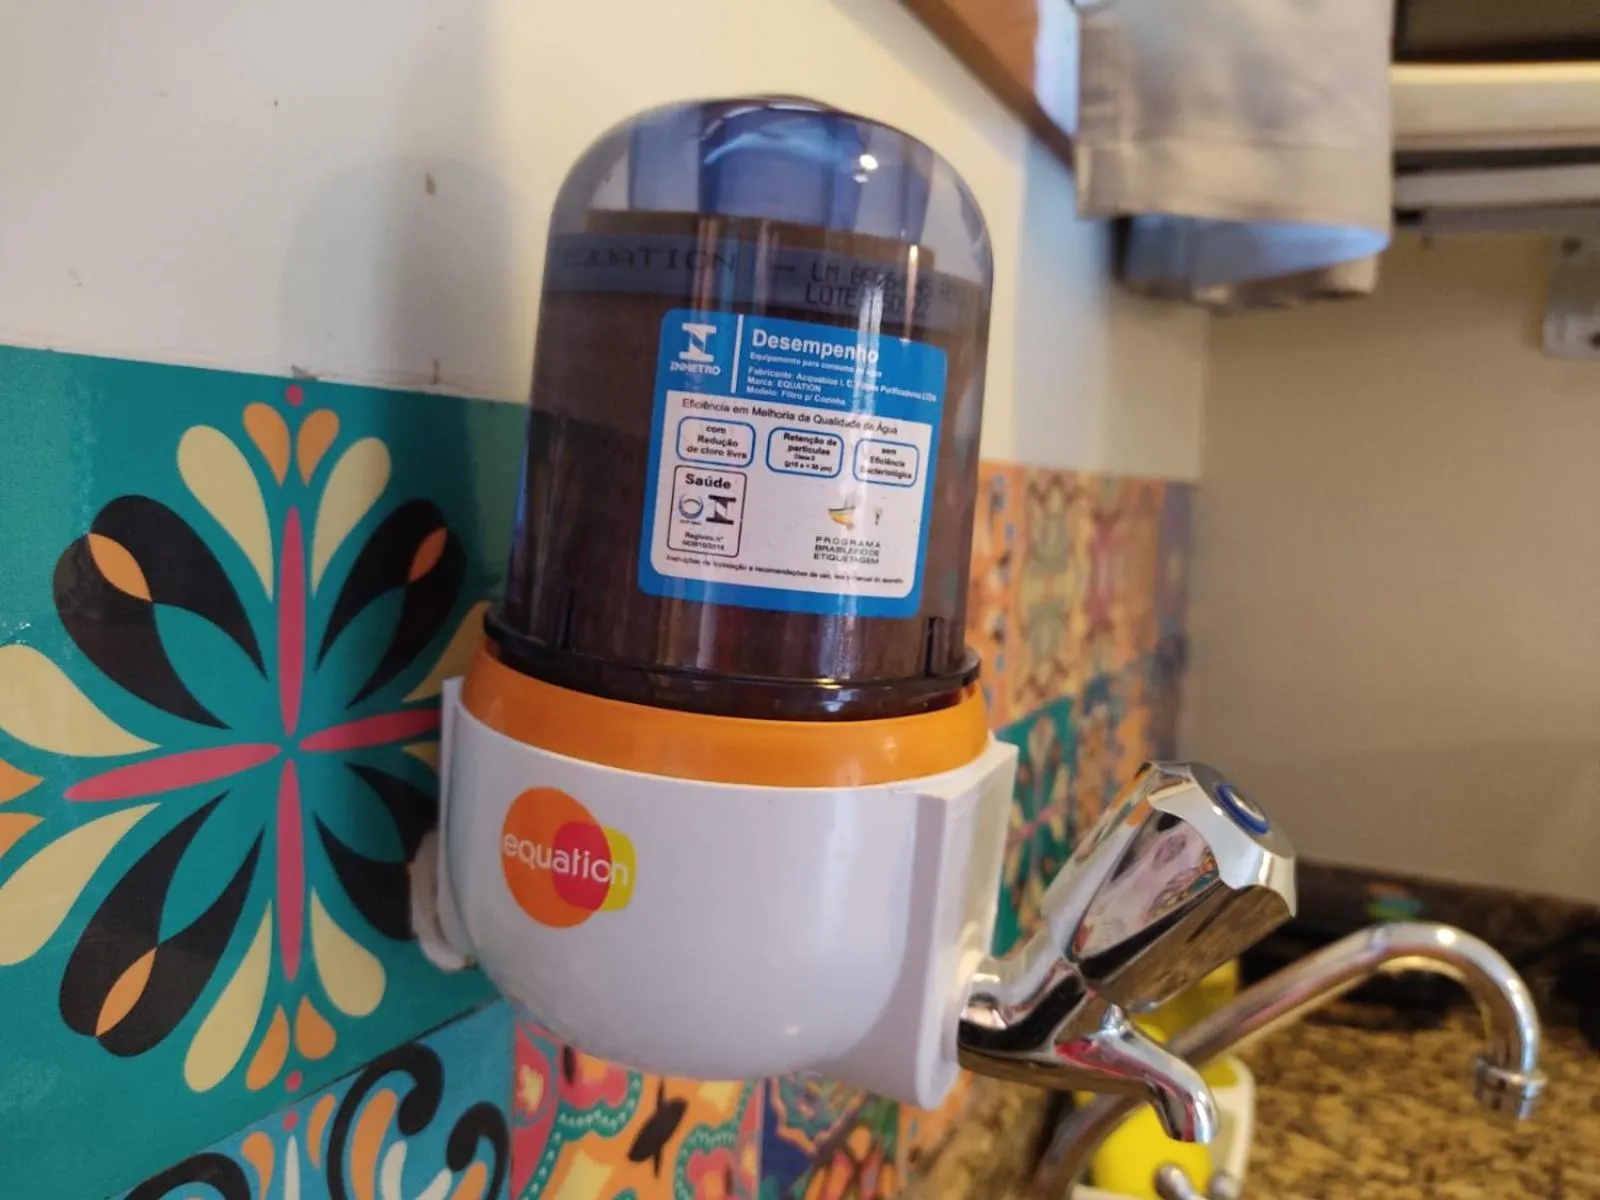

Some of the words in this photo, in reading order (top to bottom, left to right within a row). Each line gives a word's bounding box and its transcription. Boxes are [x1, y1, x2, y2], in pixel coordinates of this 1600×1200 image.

[811, 258, 839, 283] LM
[804, 281, 857, 308] LOTE
[752, 328, 879, 364] Desempenho
[670, 360, 721, 376] INMETRO
[777, 379, 822, 393] EQUATION
[781, 389, 803, 400] Filtro
[682, 398, 731, 412] Eficiência
[732, 405, 749, 415] em
[752, 405, 796, 422] Melhoria
[799, 413, 811, 423] da
[813, 413, 862, 431] Qualidade
[876, 420, 898, 436] Água
[705, 424, 727, 435] com
[697, 435, 739, 448] Redução
[783, 432, 825, 447] Retenção
[826, 438, 838, 447] de
[686, 444, 699, 454] de
[700, 446, 725, 457] cloro
[685, 472, 732, 490] Saúde
[815, 535, 881, 548] PROGRAMA
[813, 552, 880, 565] ETIQUETAGEM
[502, 833, 629, 887] equation
